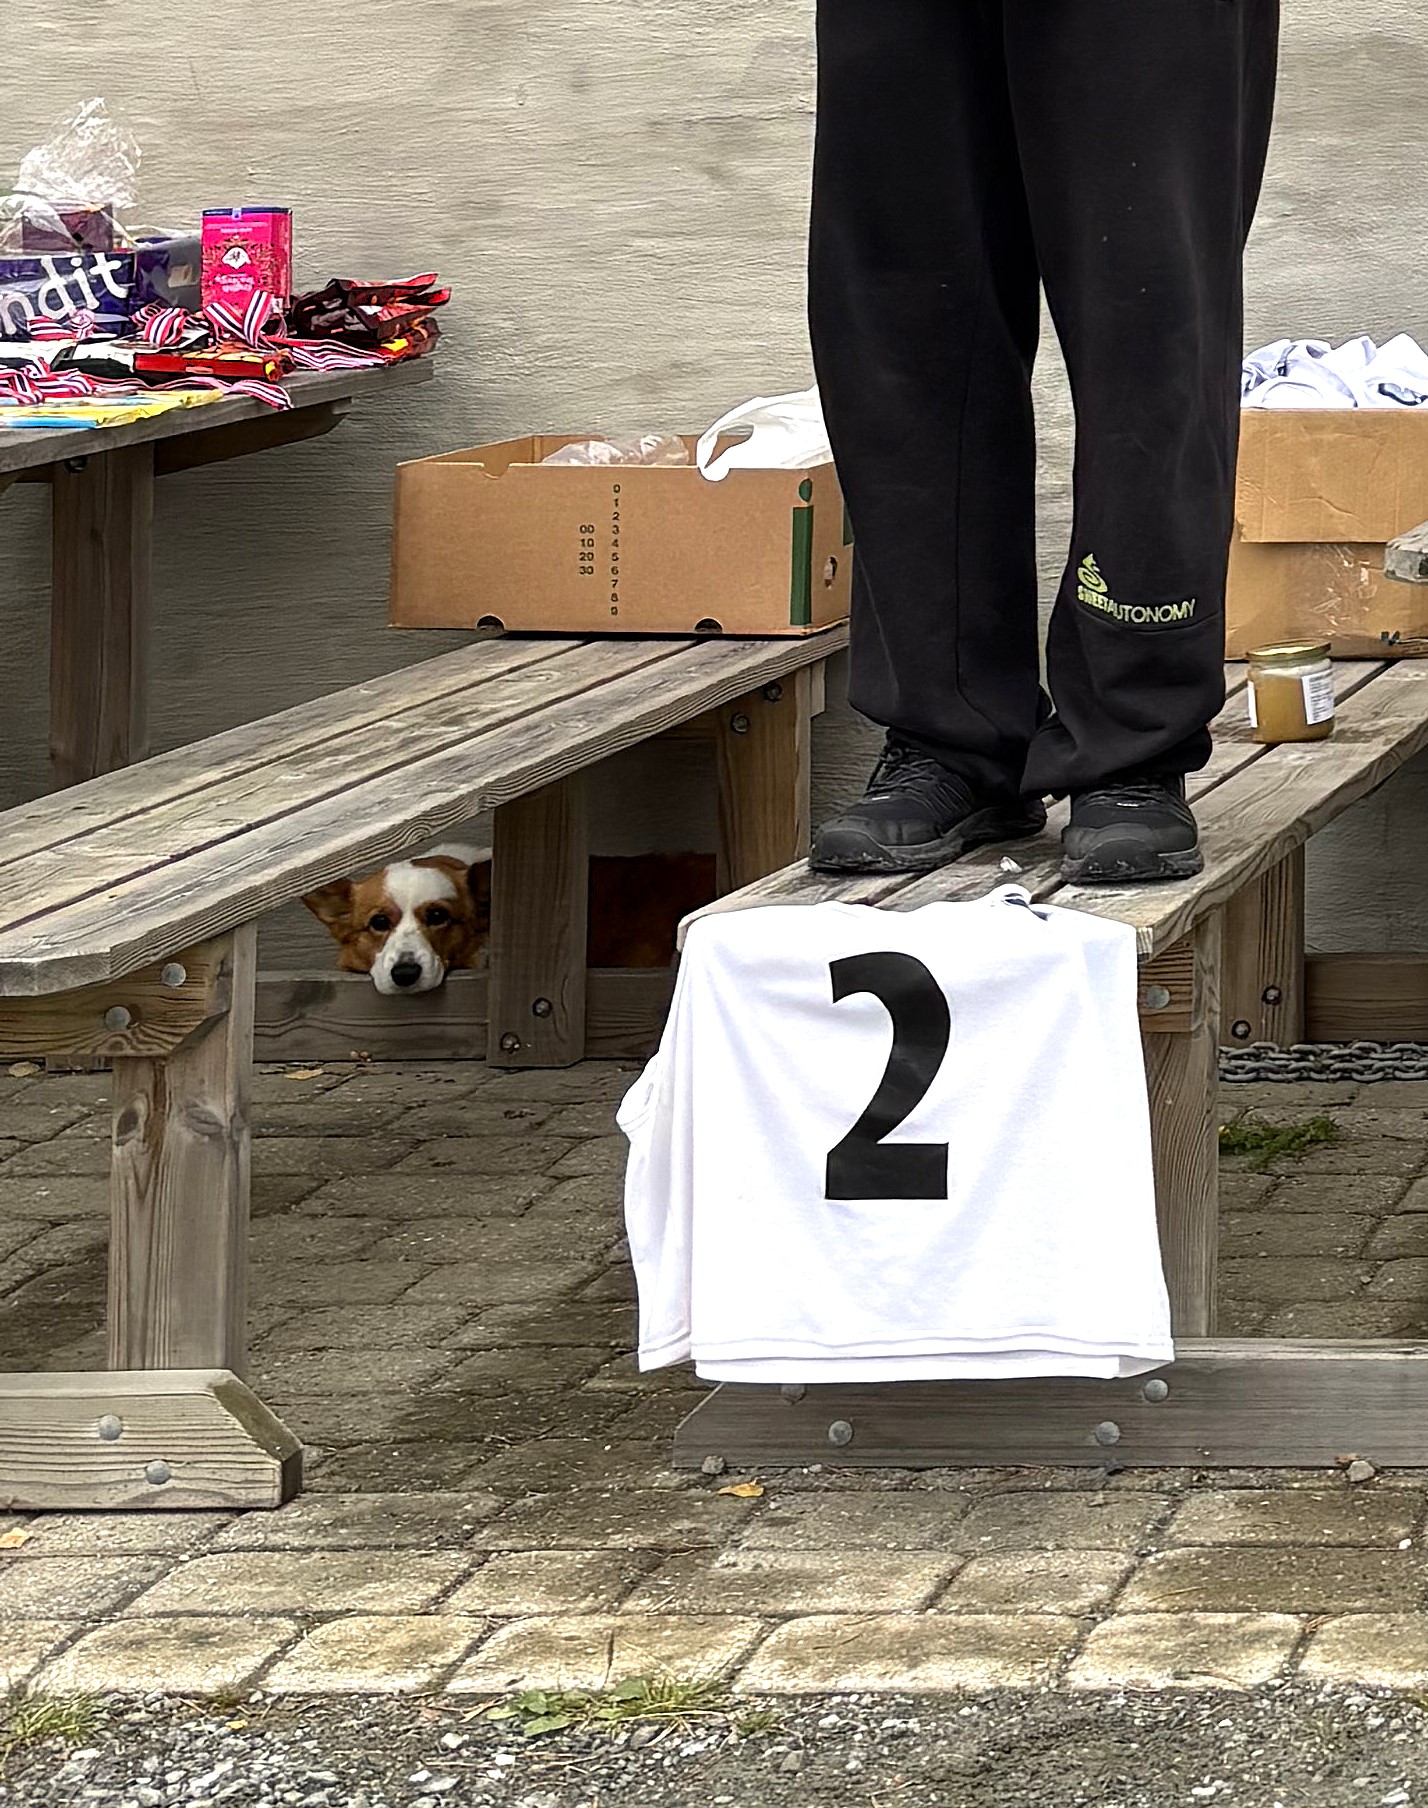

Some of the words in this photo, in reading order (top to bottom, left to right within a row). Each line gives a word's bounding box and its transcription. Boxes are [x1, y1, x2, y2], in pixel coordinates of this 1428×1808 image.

[613, 484, 620, 493] 0
[614, 498, 619, 507] 1
[612, 512, 620, 520] 2
[580, 525, 594, 533] 00
[612, 525, 619, 534] 3
[581, 538, 594, 547] 10
[612, 539, 619, 547] 4
[580, 552, 594, 561] 20
[612, 552, 619, 561] 5
[580, 566, 594, 575] 30
[611, 566, 619, 575] 6
[612, 579, 618, 588] 7
[611, 593, 618, 602] 8
[611, 606, 618, 615] 9
[825, 951, 951, 1200] 2
